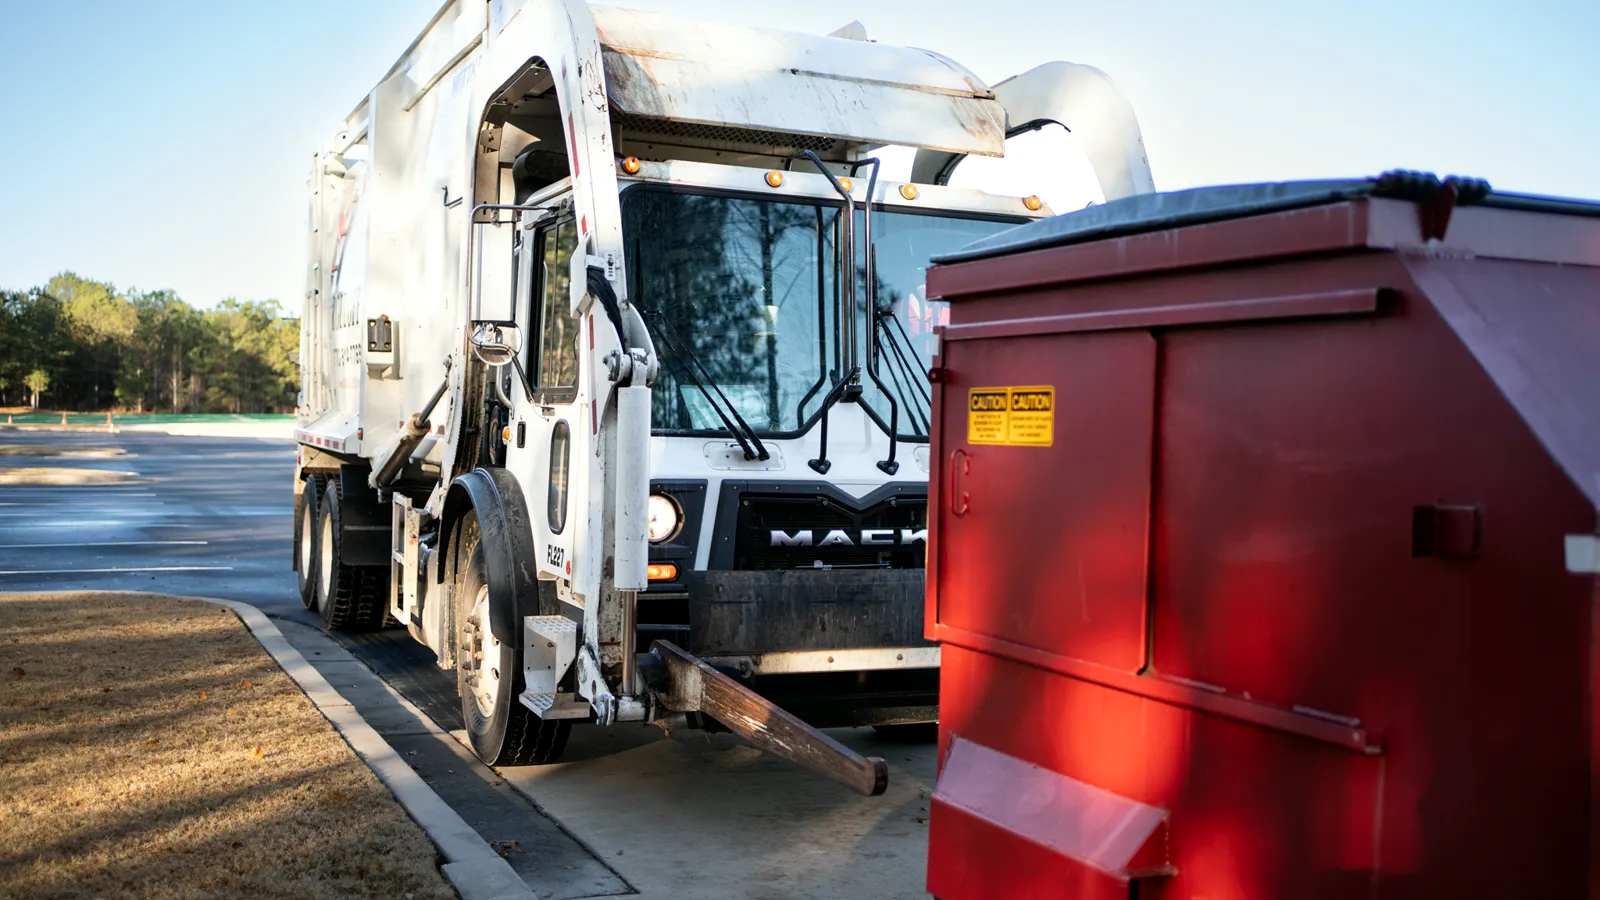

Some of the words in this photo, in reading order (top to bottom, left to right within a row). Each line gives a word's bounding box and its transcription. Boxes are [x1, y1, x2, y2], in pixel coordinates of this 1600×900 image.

[972, 395, 1006, 409] CAUTION
[1012, 394, 1050, 409] CAUTION
[770, 529, 928, 546] MACK
[547, 544, 564, 568] FL227
